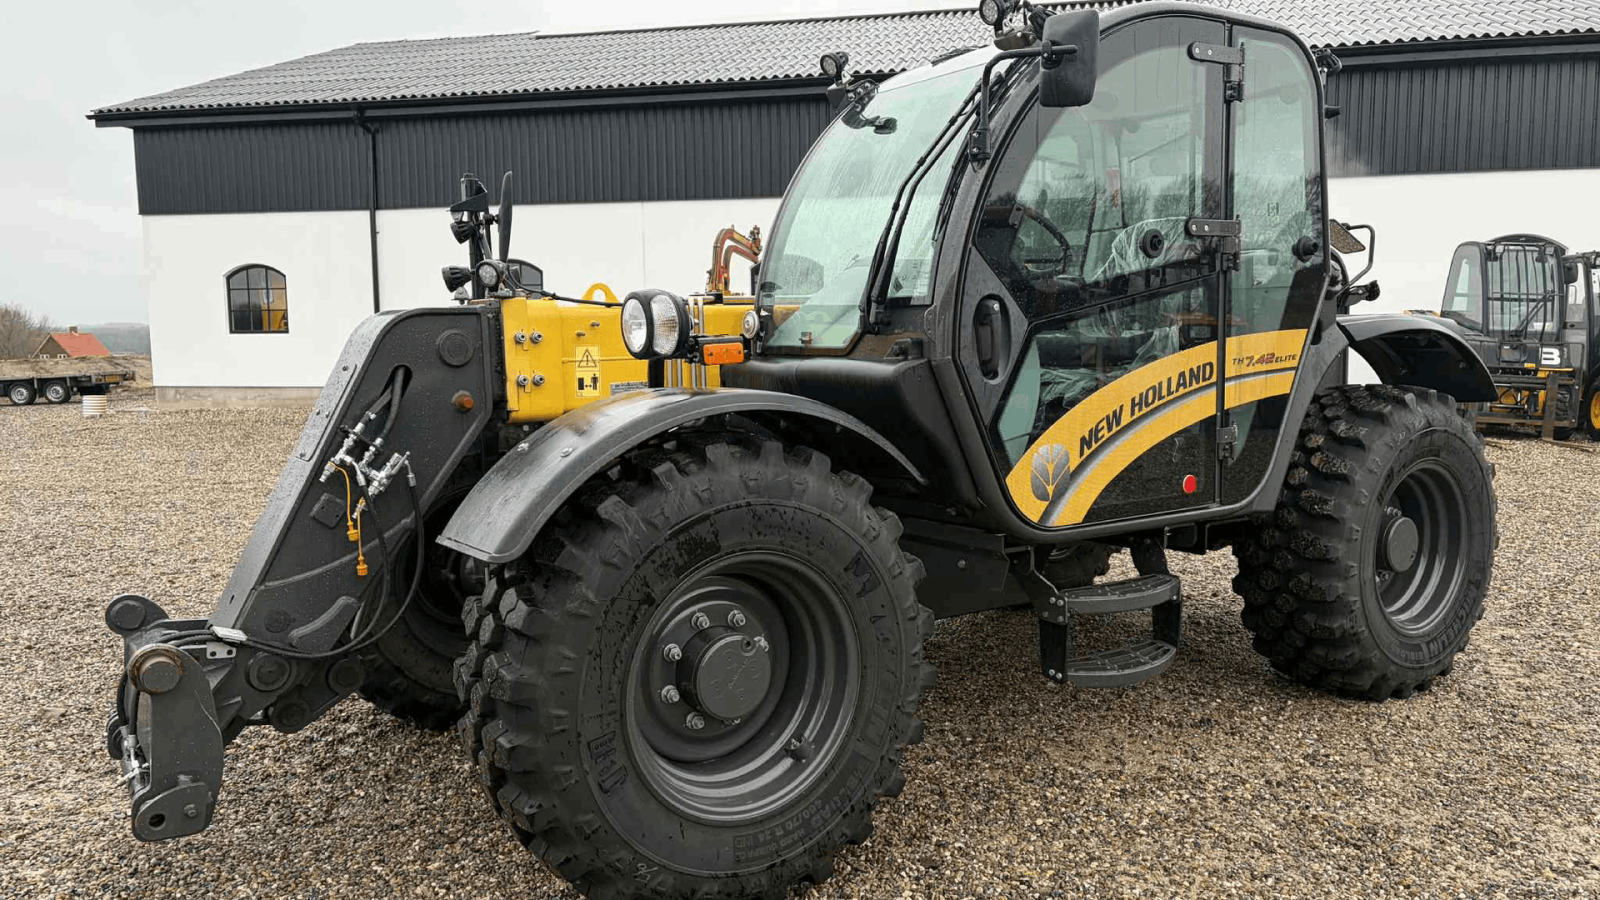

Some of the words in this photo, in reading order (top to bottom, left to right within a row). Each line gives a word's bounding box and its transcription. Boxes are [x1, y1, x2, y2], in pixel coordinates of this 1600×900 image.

[1232, 356, 1245, 366] TH
[1275, 353, 1298, 363] ELITE
[1079, 403, 1125, 458] NEW
[1130, 361, 1215, 418] HOLLAND
[784, 800, 822, 830] 460/70
